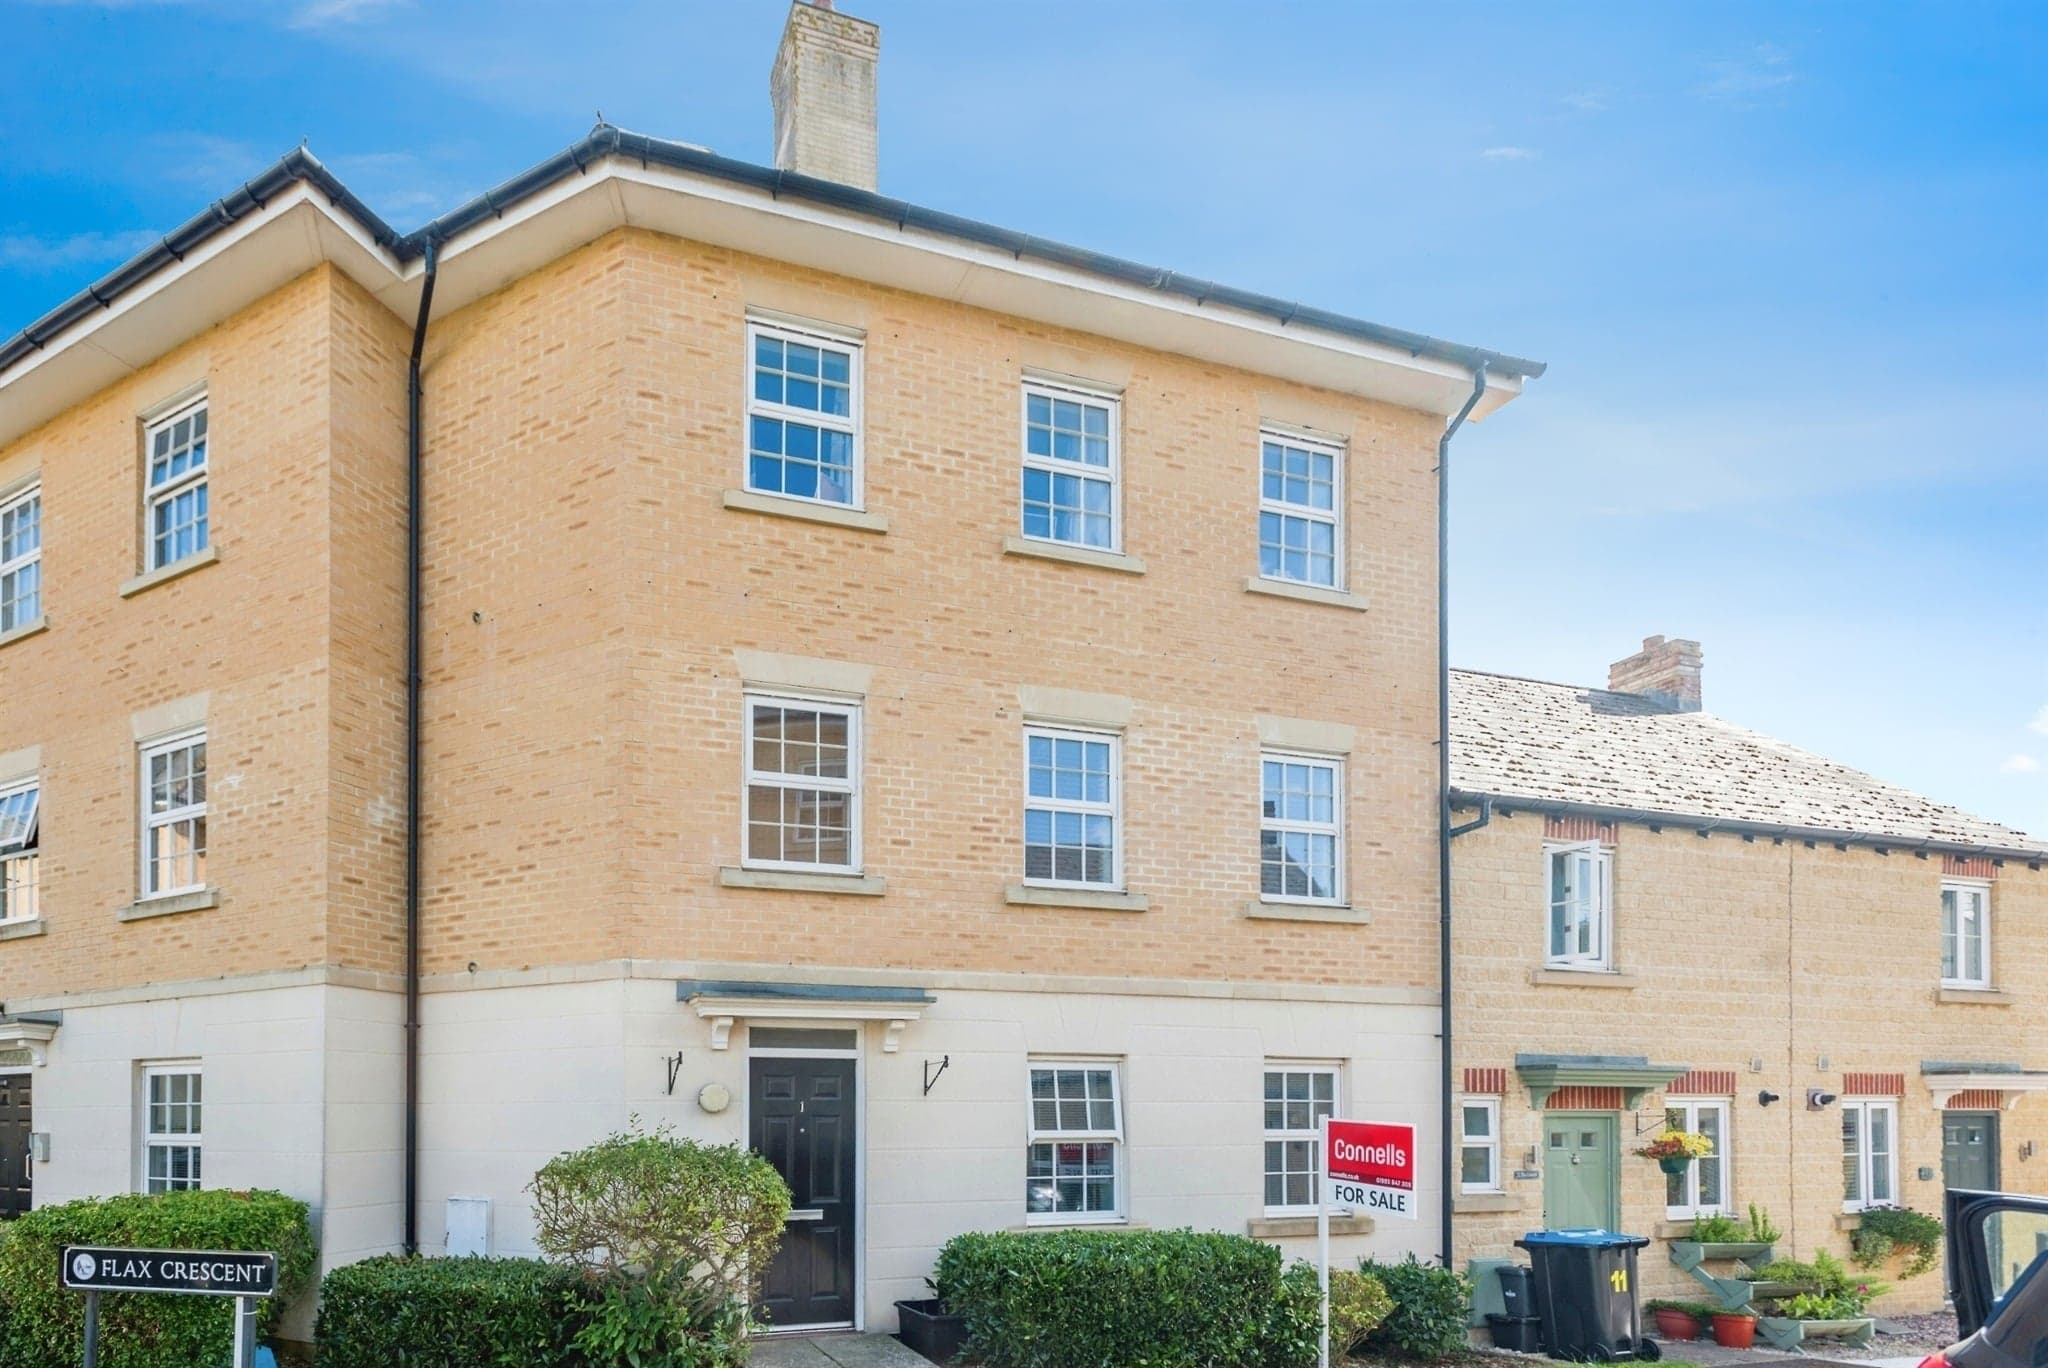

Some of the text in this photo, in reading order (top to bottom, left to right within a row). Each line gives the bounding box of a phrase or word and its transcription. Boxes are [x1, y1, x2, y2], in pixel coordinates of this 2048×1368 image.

[1334, 1138, 1406, 1168] Connells
[1335, 1185, 1406, 1212] FOR SALE
[101, 1259, 266, 1283] FLAX CRESCENT
[1610, 1269, 1628, 1293] 11
